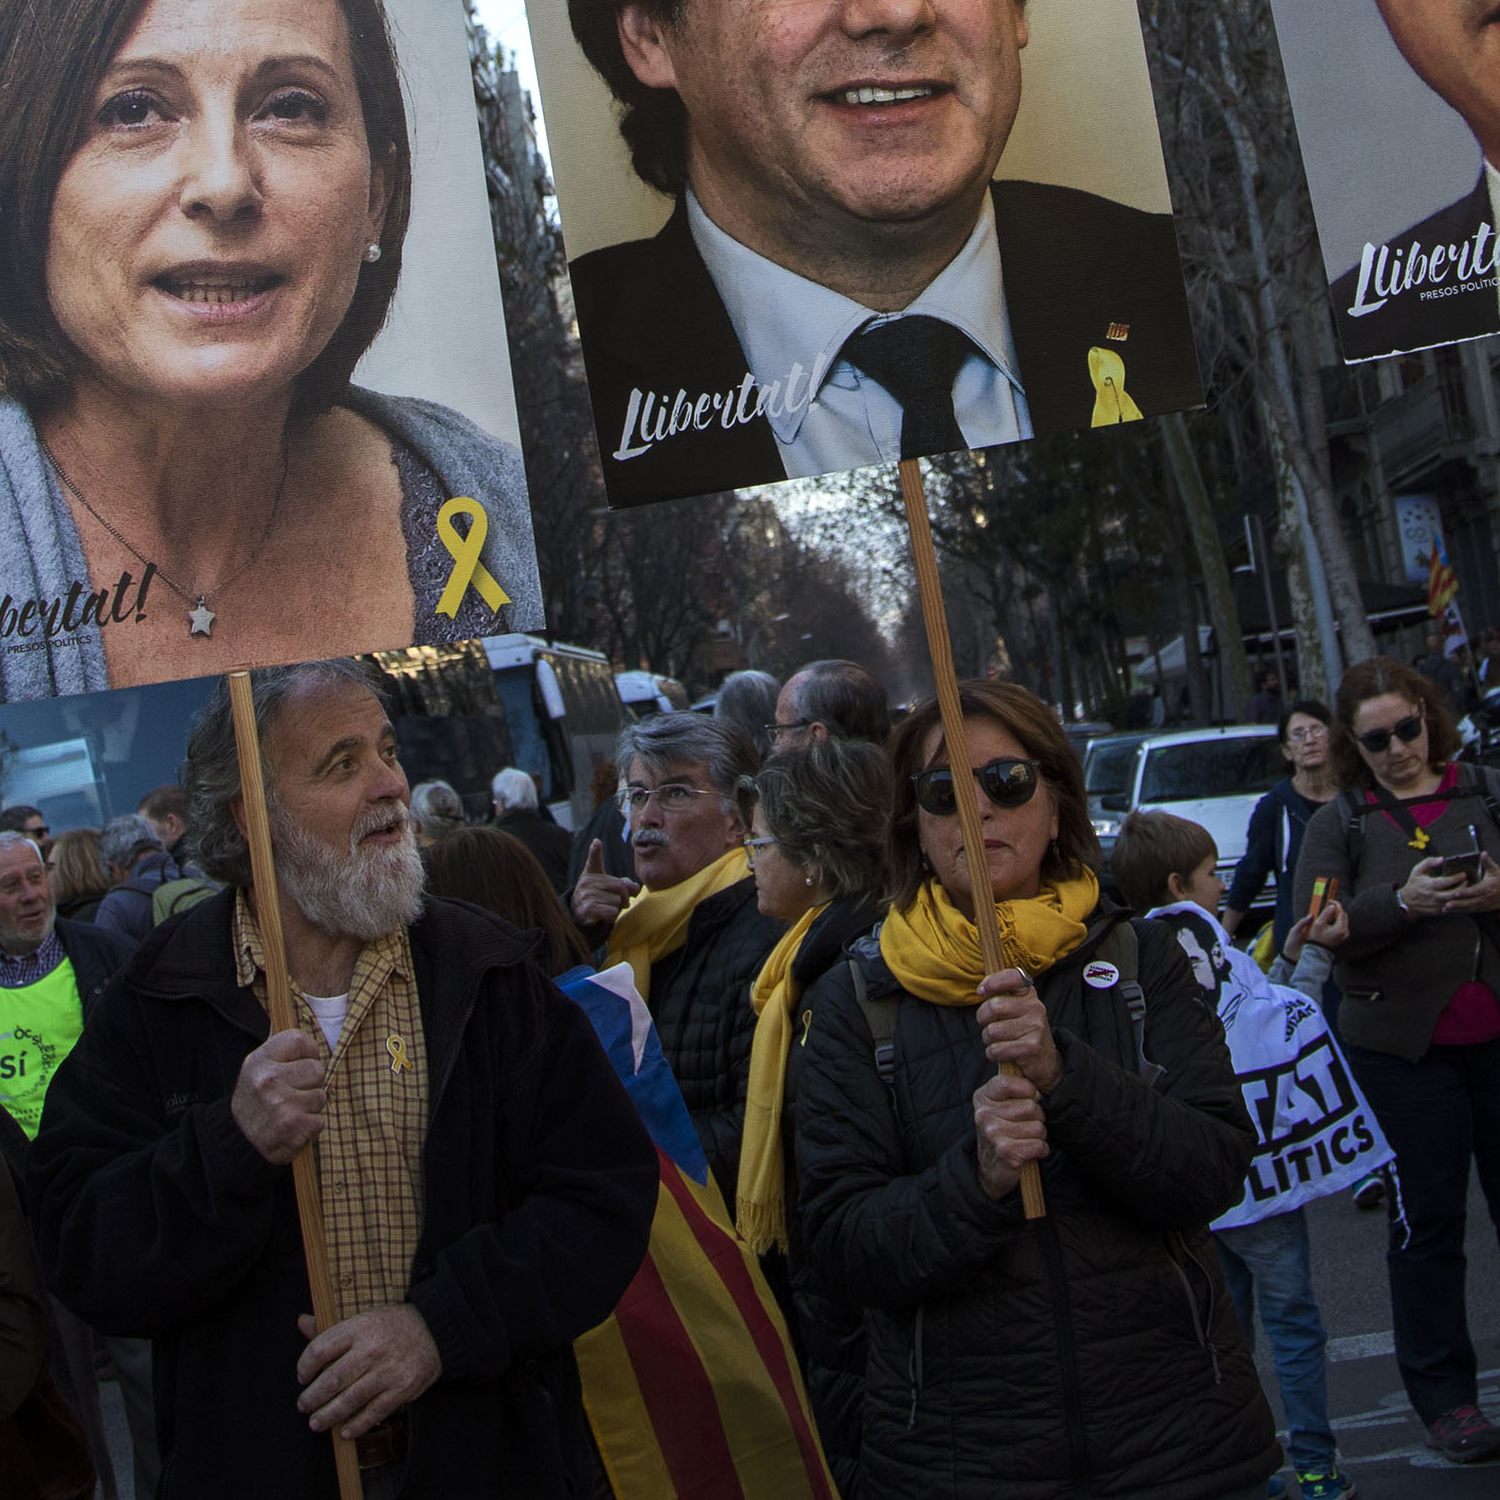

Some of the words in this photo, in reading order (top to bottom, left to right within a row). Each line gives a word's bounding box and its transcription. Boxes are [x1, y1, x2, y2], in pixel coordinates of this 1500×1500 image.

[1419, 284, 1459, 301] PRESOS
[612, 352, 827, 461] Llibertat!
[7, 640, 46, 654] PRESOS
[49, 635, 92, 648] POLÍTICS
[0, 1050, 28, 1079] Sí
